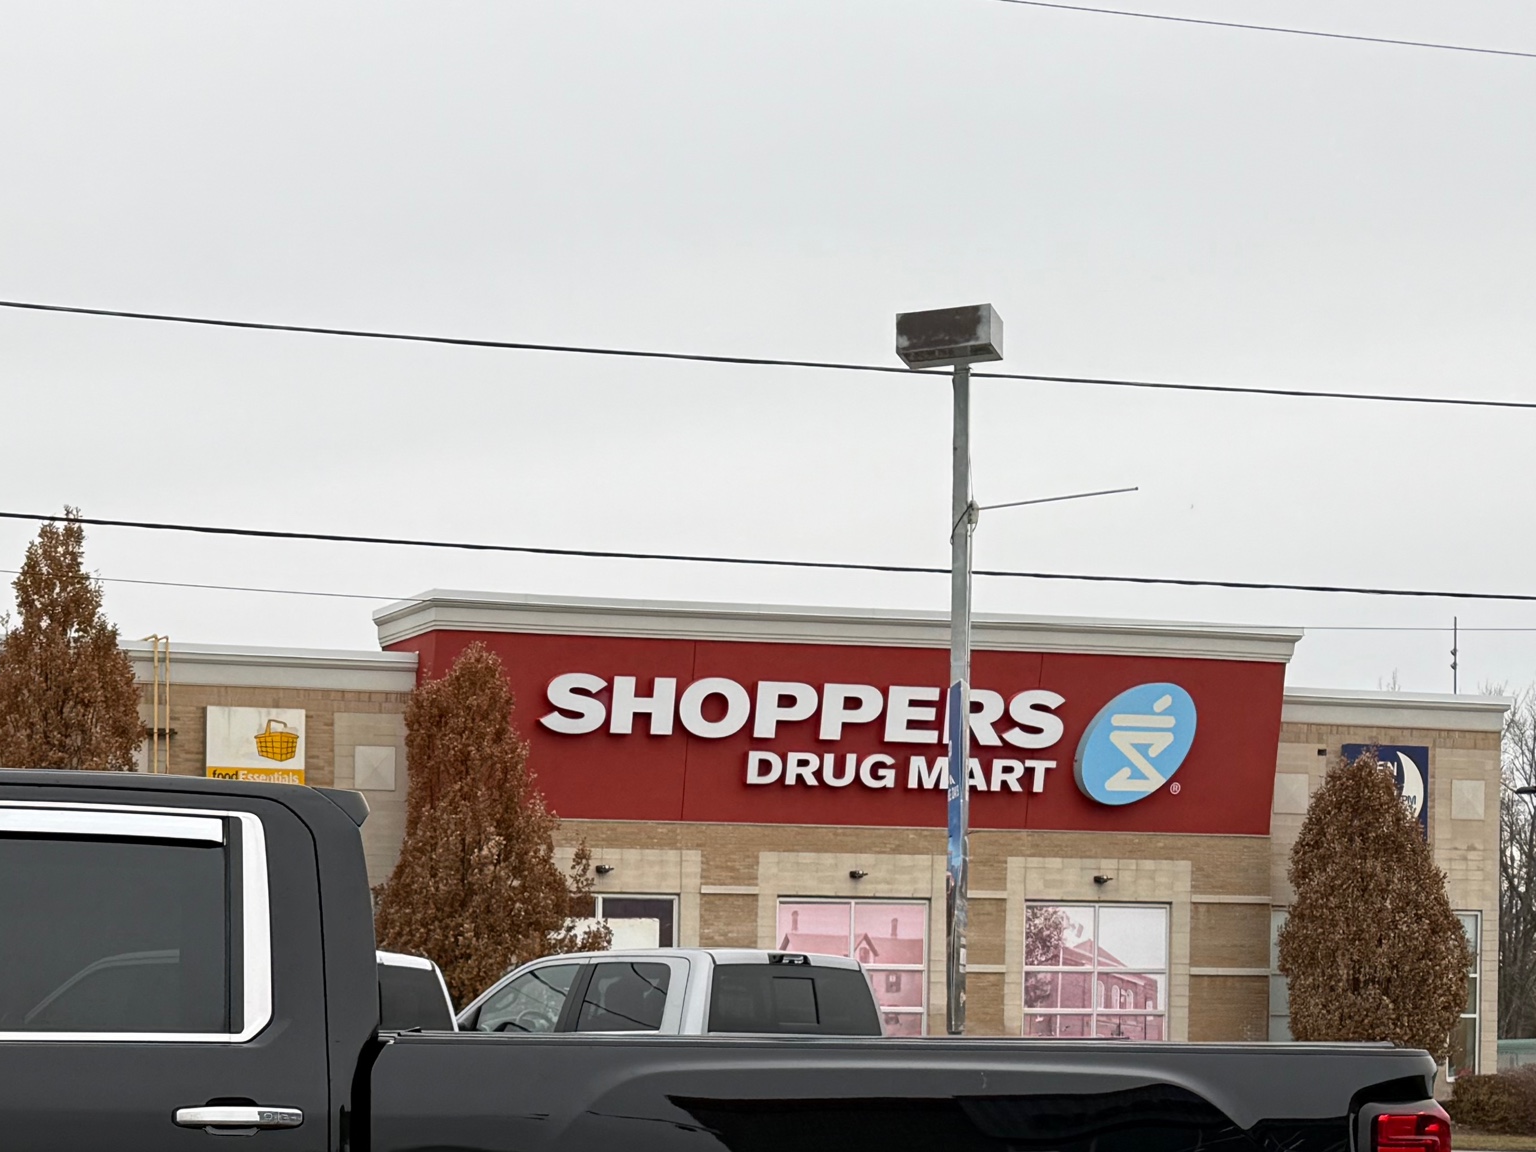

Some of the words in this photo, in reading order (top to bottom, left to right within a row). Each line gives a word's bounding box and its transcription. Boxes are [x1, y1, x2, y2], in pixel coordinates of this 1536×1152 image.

[541, 672, 1066, 749] SHOPPERS
[746, 750, 895, 789] DRUG
[907, 754, 1057, 793] MART
